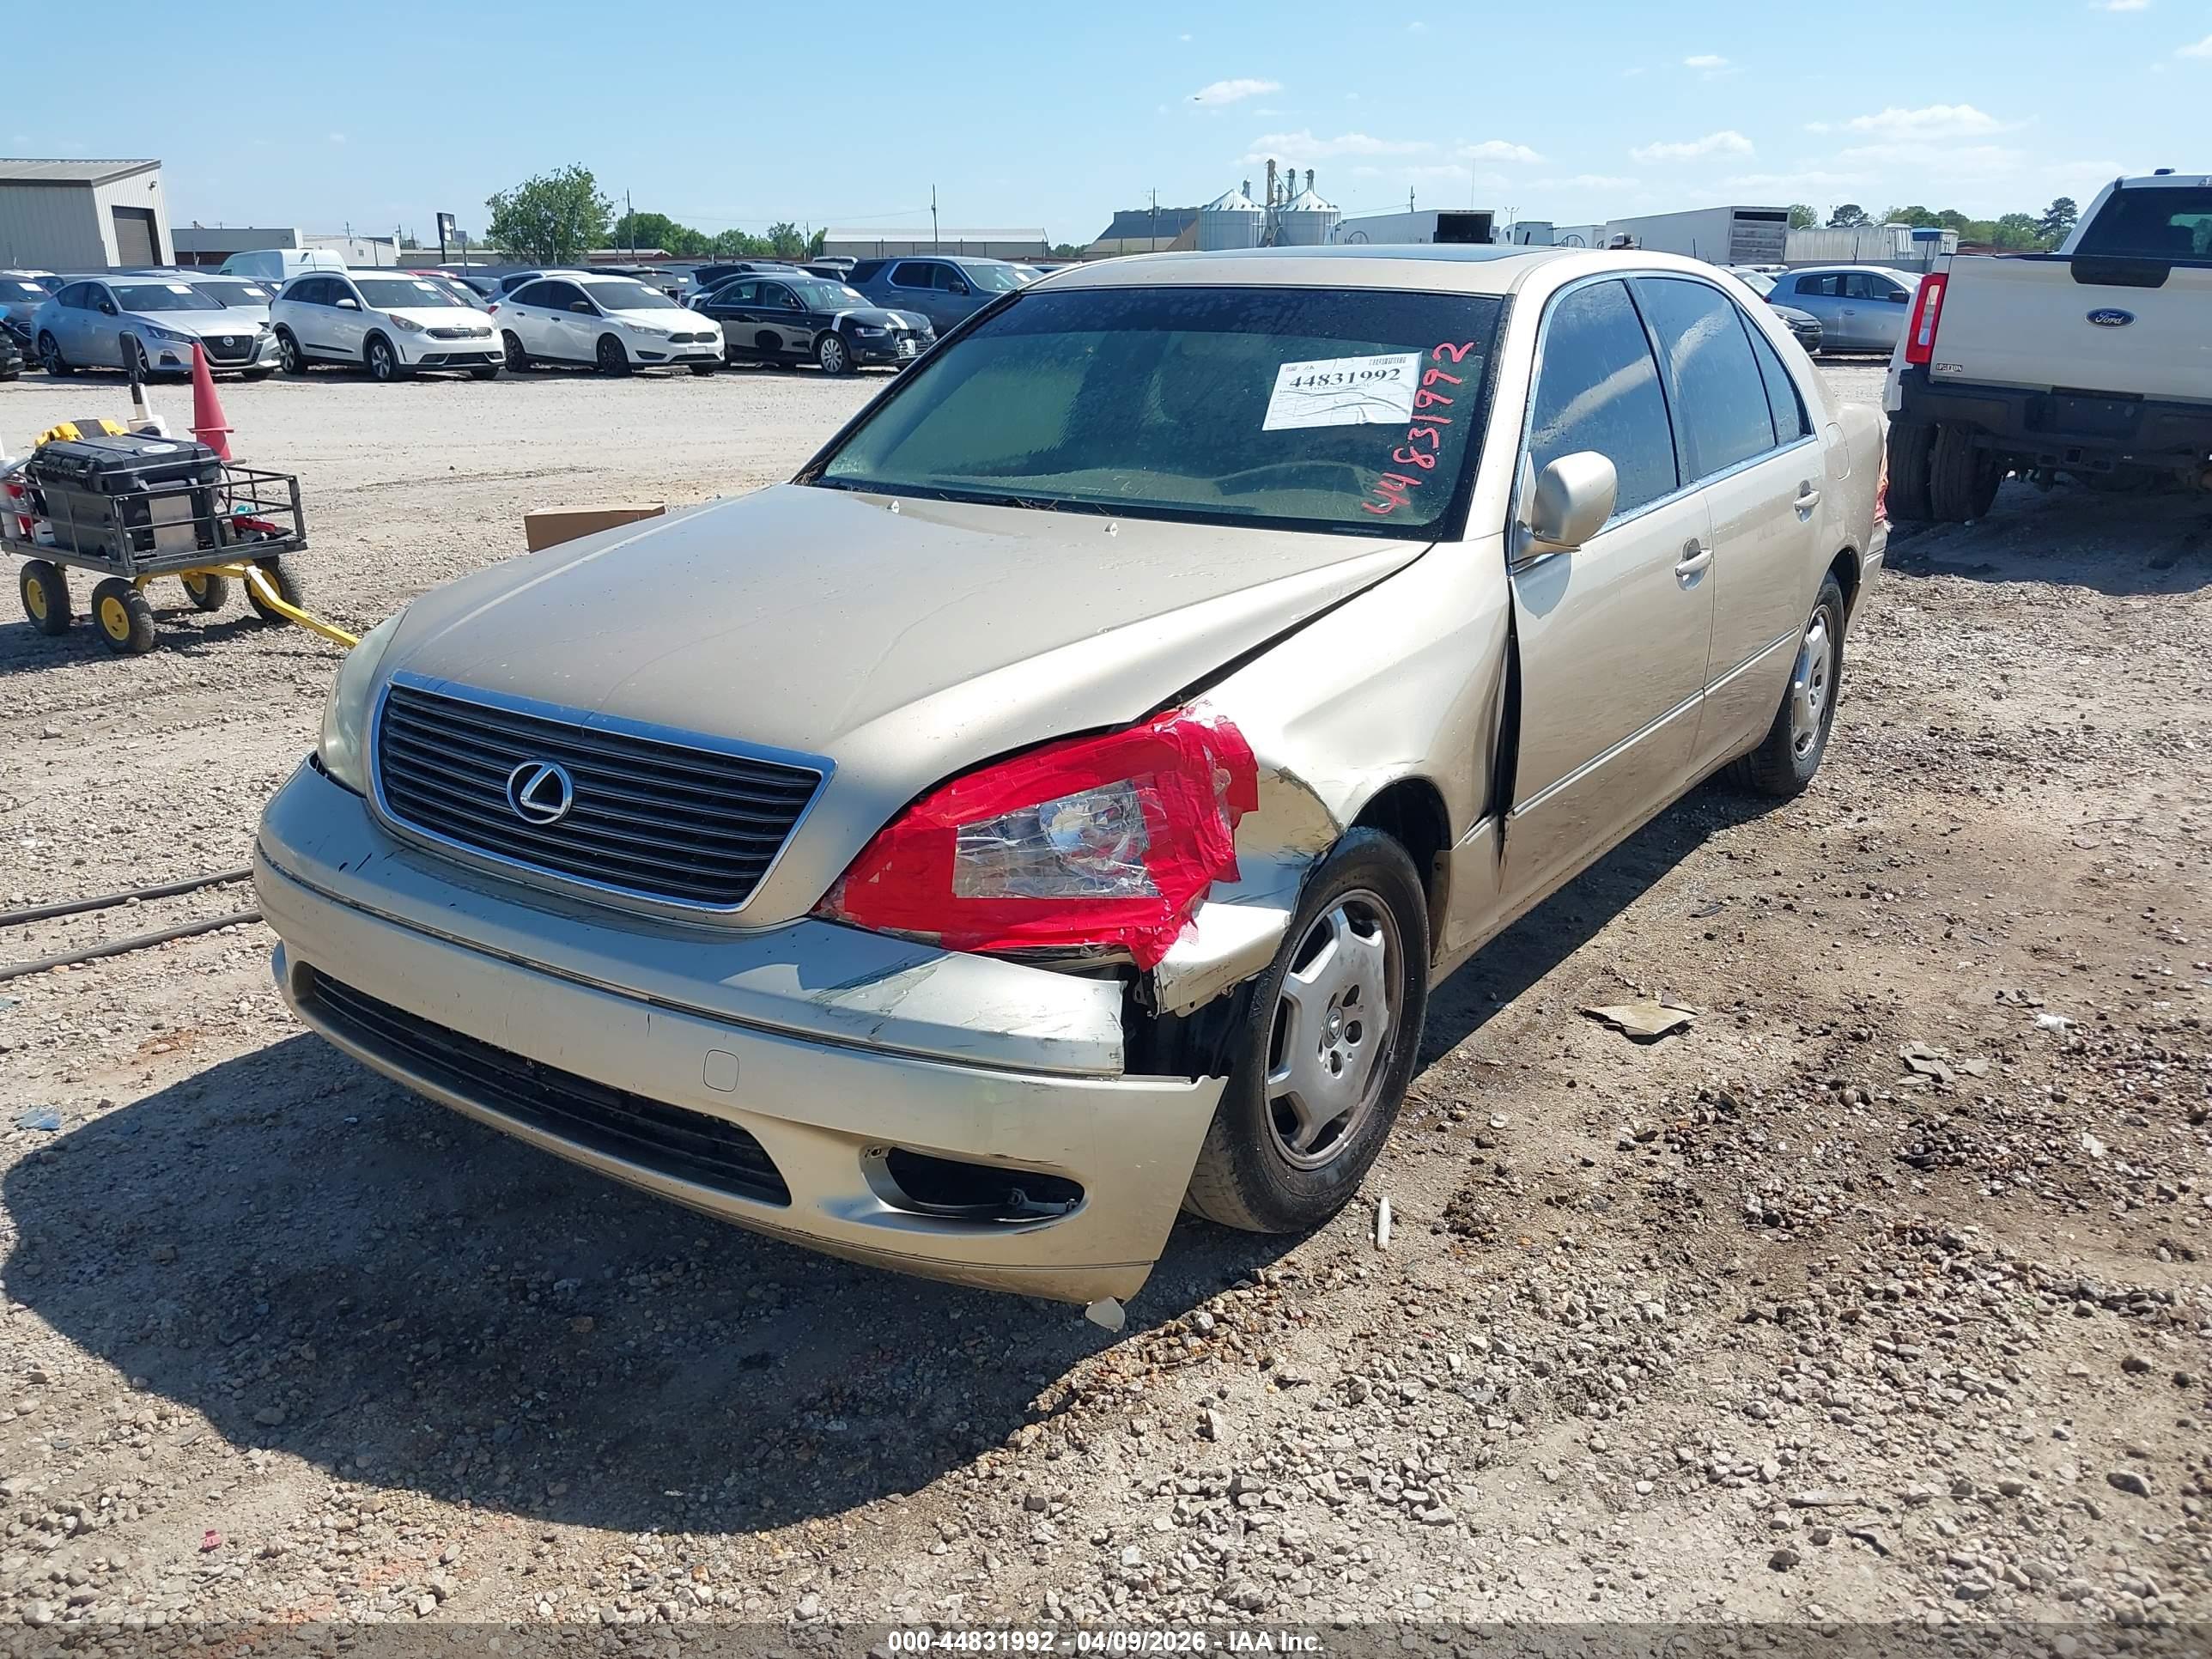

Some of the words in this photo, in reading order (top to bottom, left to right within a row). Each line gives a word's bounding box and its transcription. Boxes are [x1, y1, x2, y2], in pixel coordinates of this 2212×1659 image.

[2095, 311, 2125, 325] Ford
[1289, 368, 1401, 388] 44831992
[1362, 341, 1475, 514] 44831992
